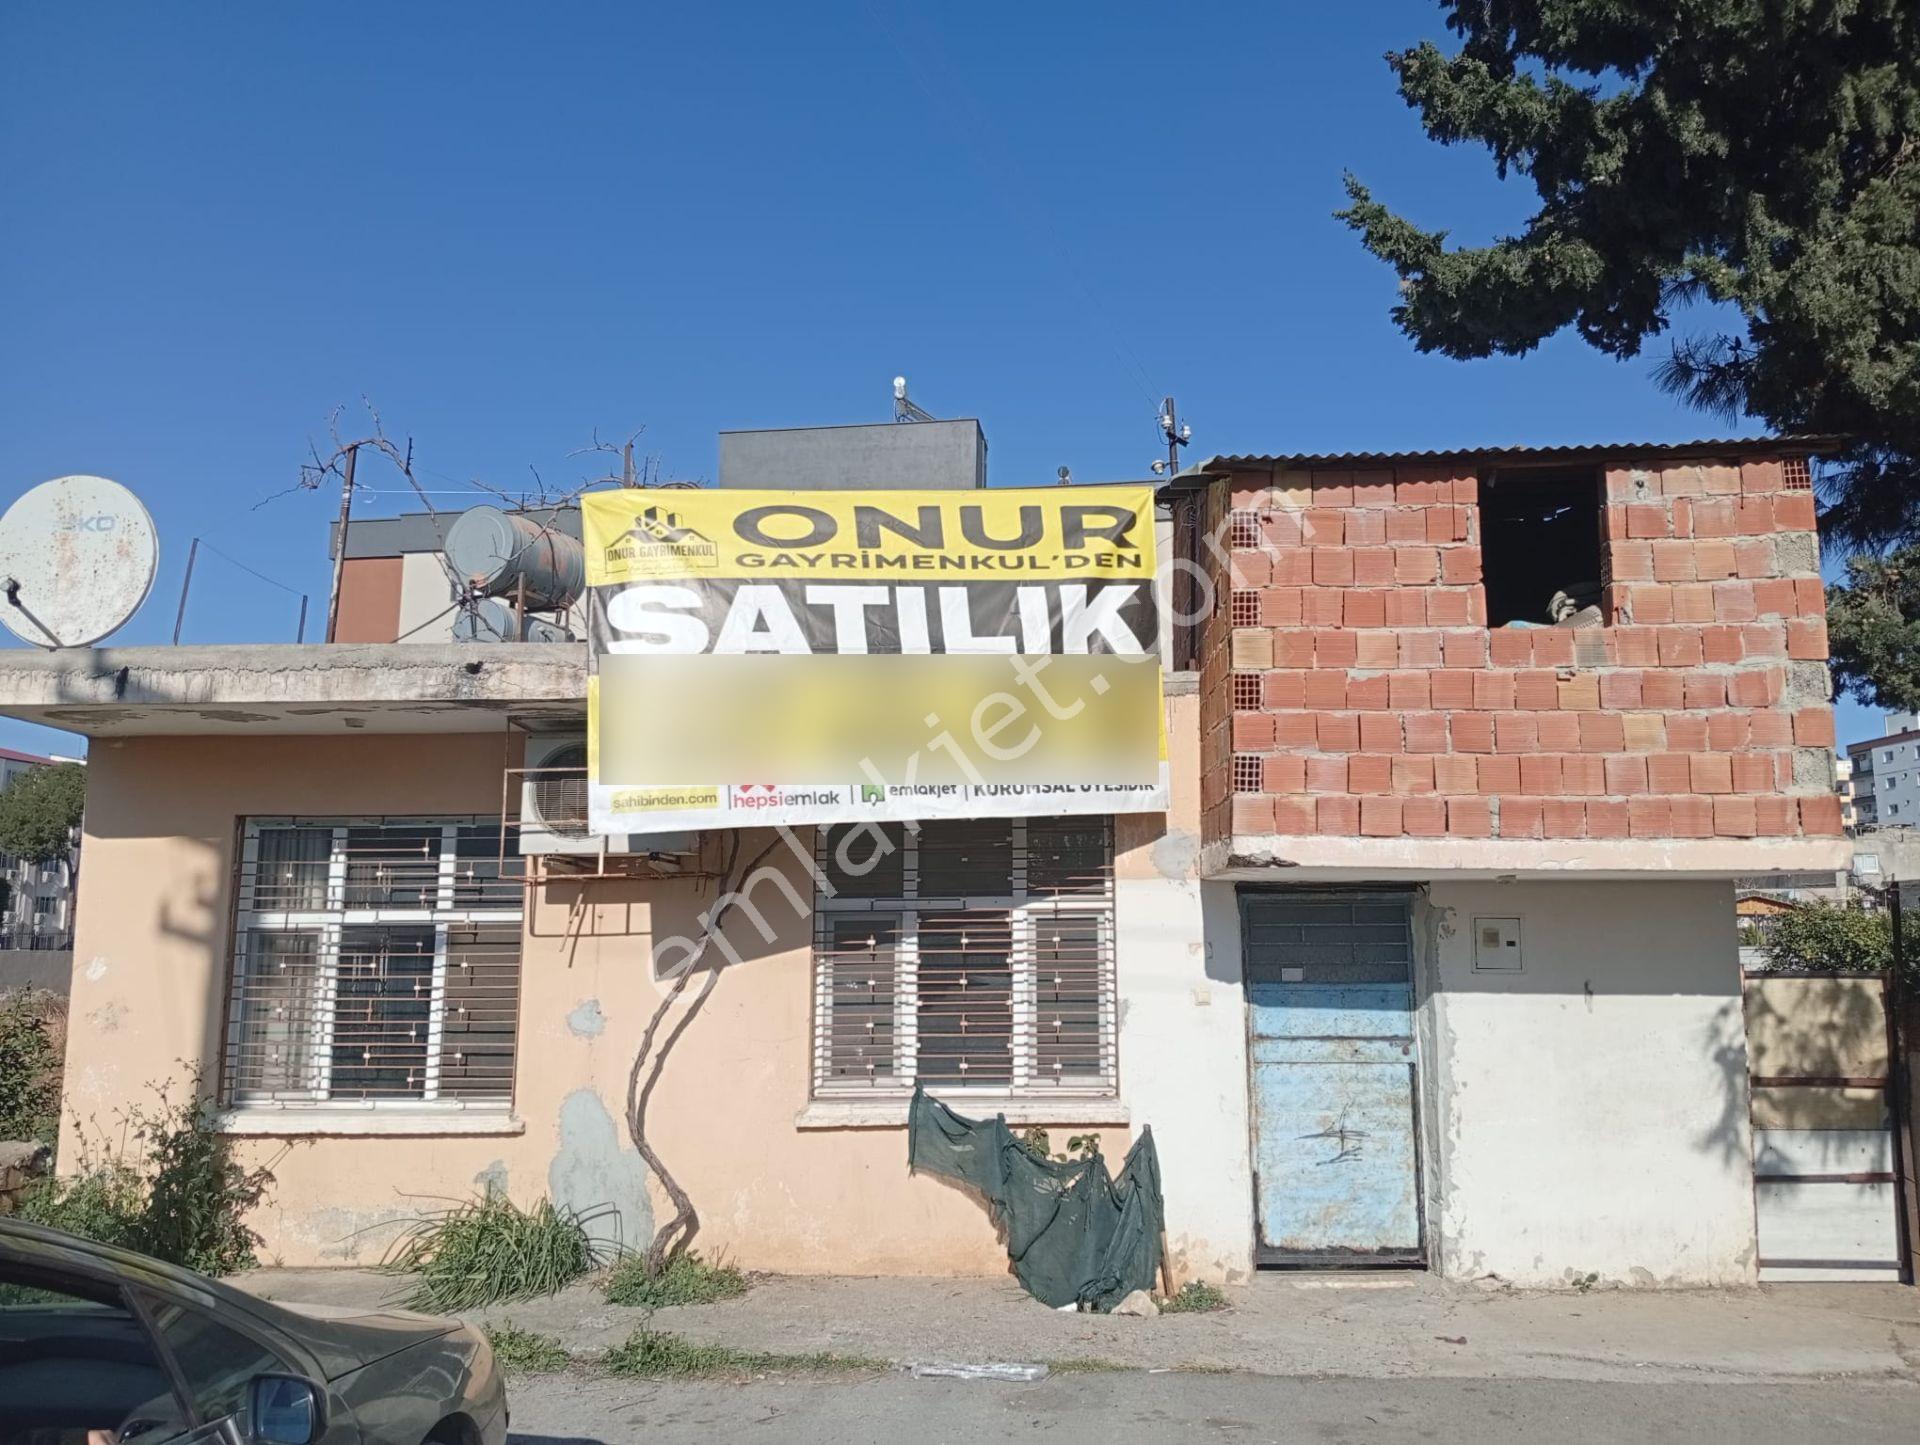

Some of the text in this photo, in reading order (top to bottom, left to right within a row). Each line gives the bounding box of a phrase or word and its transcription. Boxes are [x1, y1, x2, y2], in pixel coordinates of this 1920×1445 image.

[733, 505, 1139, 550] ONUR
[607, 547, 636, 562] ONUR
[607, 584, 1147, 654] SATILIK
[613, 793, 717, 809] sahibinden.com
[733, 790, 840, 811] hepsiemlak
